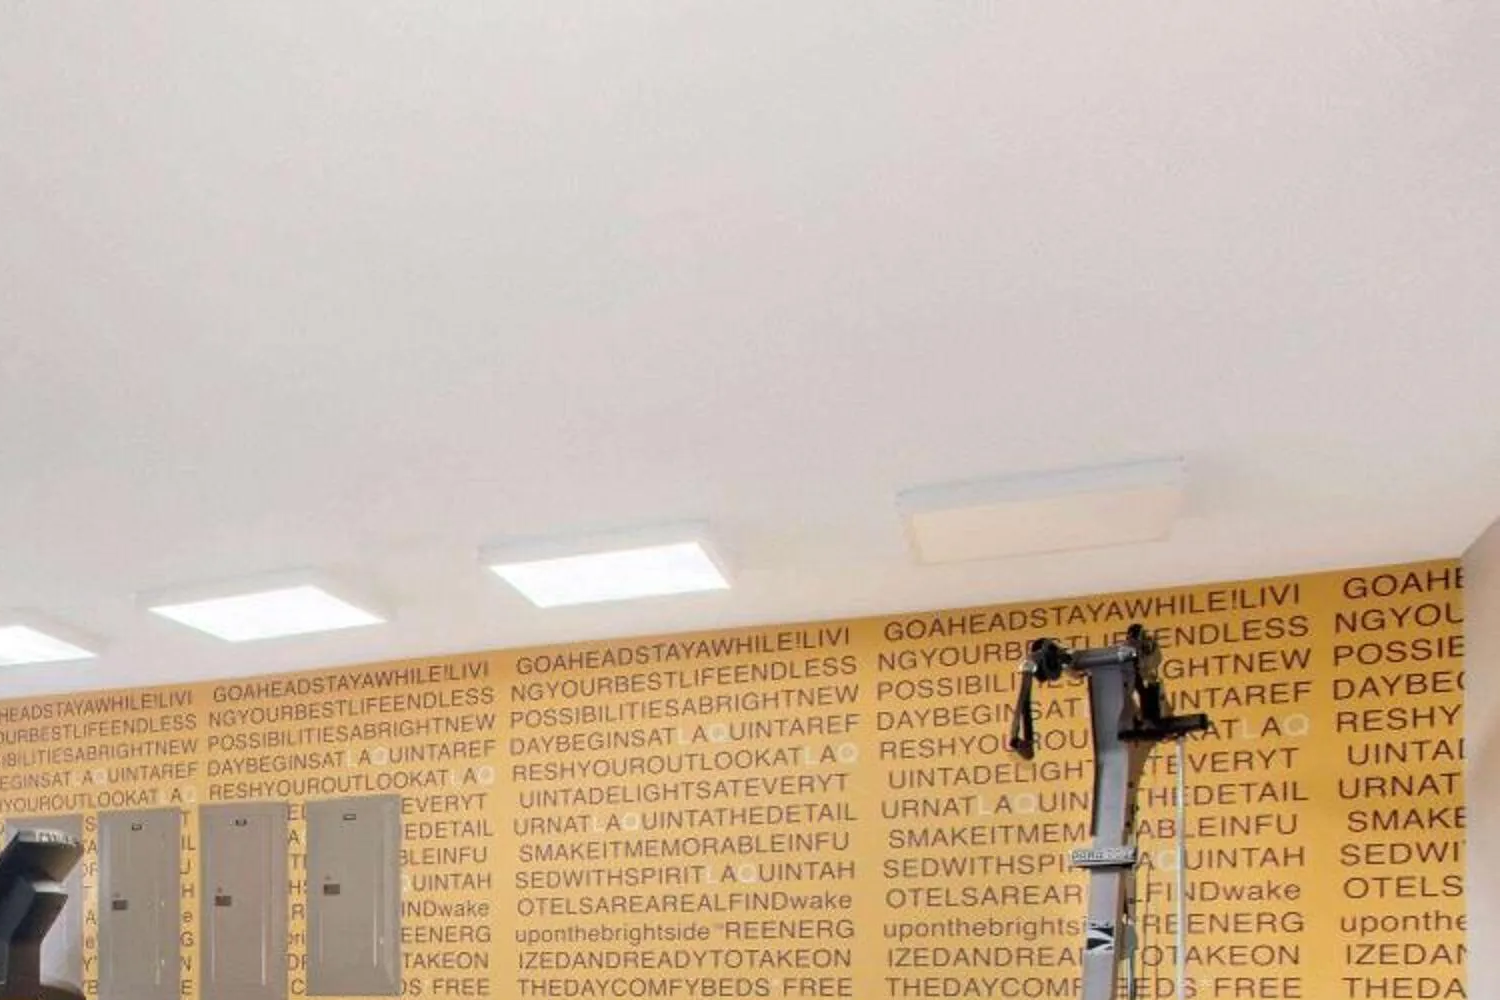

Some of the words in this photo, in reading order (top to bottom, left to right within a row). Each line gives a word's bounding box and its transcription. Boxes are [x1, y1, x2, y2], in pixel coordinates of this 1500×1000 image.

[511, 655, 857, 703] NGYOURBESTLIFEENDLESS
[209, 687, 493, 728] NGYOURBESTLIFEENDLESS
[510, 684, 859, 729] POSSIBILITIESABRIGHTNEW
[208, 714, 495, 752] POSSIBILITIESABRIGHTNEW
[1346, 738, 1465, 766] UINTA
[519, 773, 849, 809] UINTADELIGHTSATEVERYT
[519, 832, 849, 863] SMAKEITMEMORABLEINFU
[1340, 841, 1465, 866] SEDWI
[1343, 875, 1463, 899] OTELS
[517, 890, 852, 916] OTELSAREAREALFINDwake
[402, 926, 490, 944] EENERG
[519, 949, 851, 969] IZEDANDREADYTOTAKEON
[432, 979, 488, 996] FREE
[1215, 978, 1301, 998] FREE
[1341, 977, 1467, 999] THEDA
